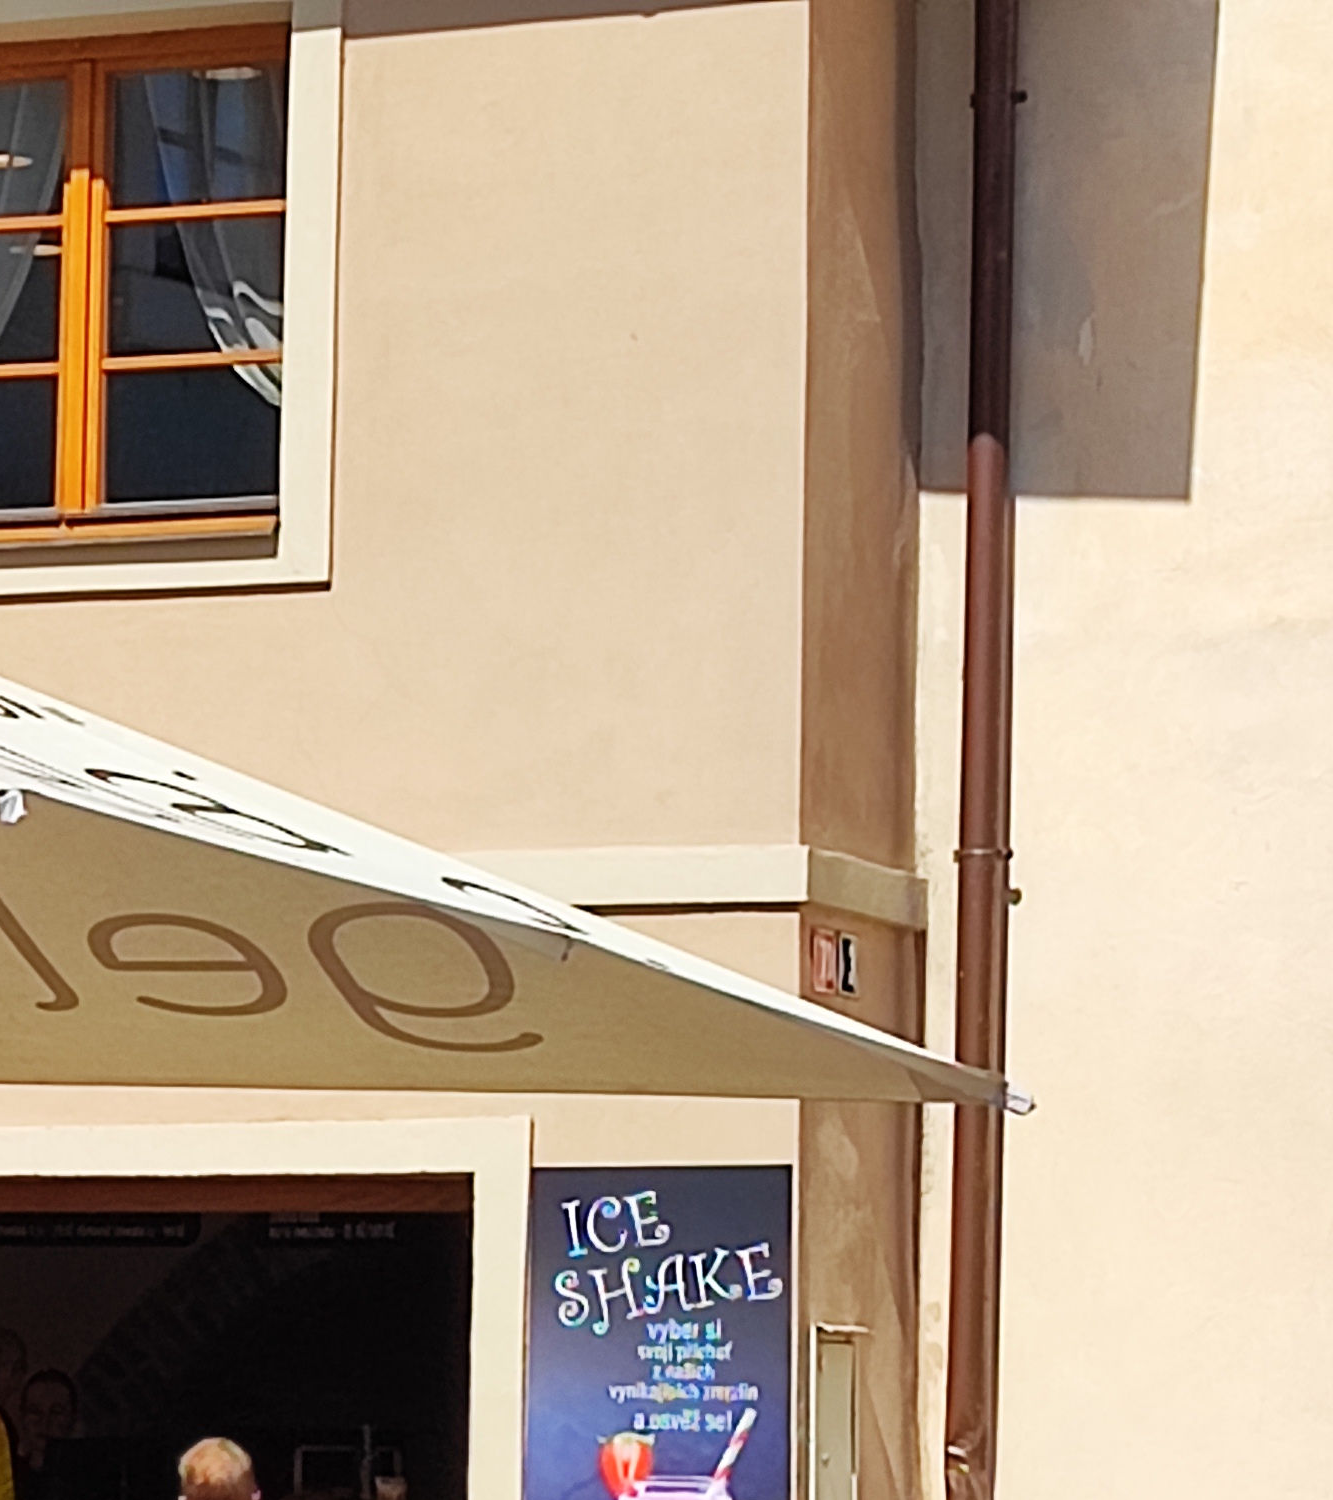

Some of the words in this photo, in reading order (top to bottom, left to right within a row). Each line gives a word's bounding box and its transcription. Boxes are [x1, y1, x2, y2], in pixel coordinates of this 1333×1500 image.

[561, 1190, 671, 1257] ICE
[554, 1242, 783, 1335] SHAKE
[646, 1317, 699, 1344] vyber
